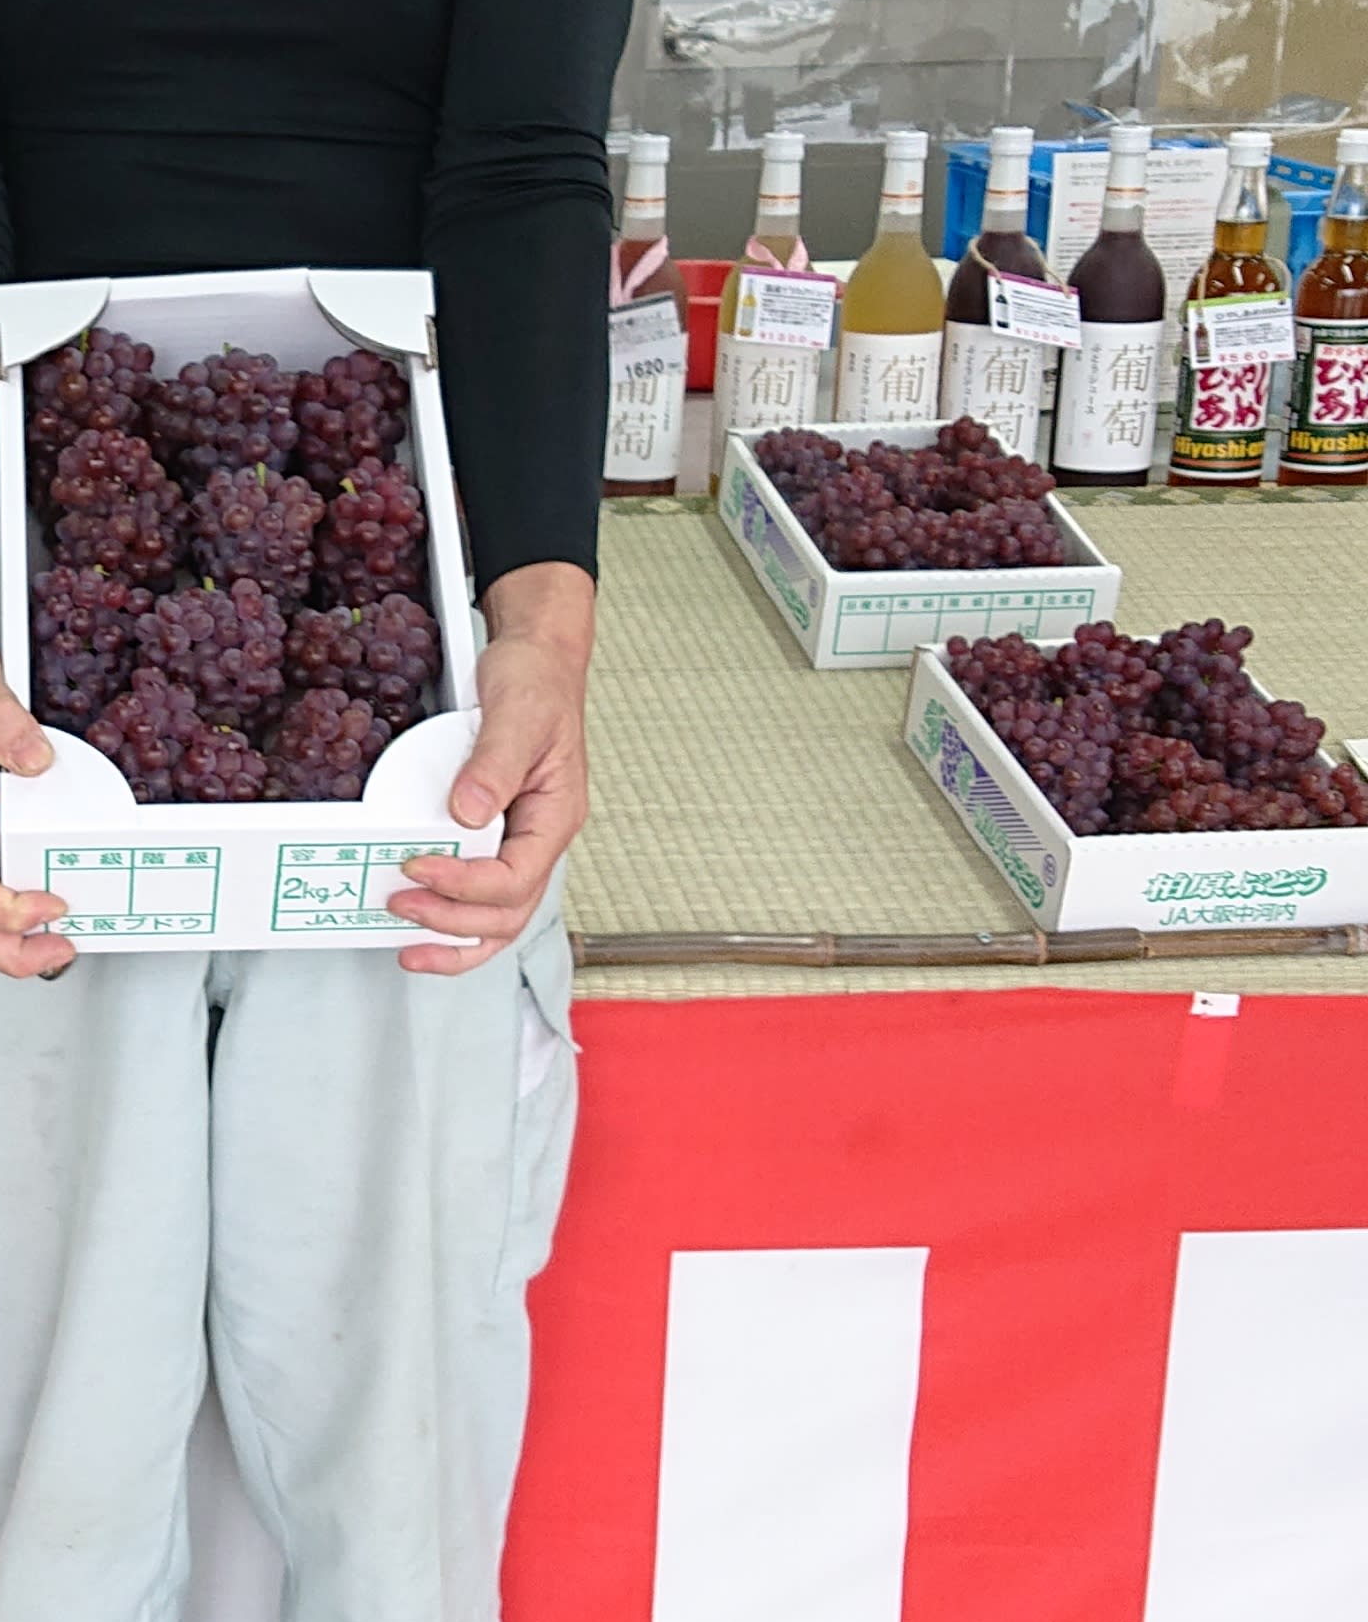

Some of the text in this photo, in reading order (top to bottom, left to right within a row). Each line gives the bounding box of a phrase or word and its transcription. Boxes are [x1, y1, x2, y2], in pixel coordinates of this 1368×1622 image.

[625, 357, 665, 379] 1620
[1103, 344, 1154, 447] 葡萄
[1194, 393, 1262, 428] あめ
[57, 851, 124, 866] 等級
[142, 850, 209, 866] 階級
[290, 847, 360, 862] 容量
[282, 877, 358, 904] 2kg入
[1141, 866, 1329, 902] 柏原ぶどう
[59, 915, 202, 932] 大阪ブドウ
